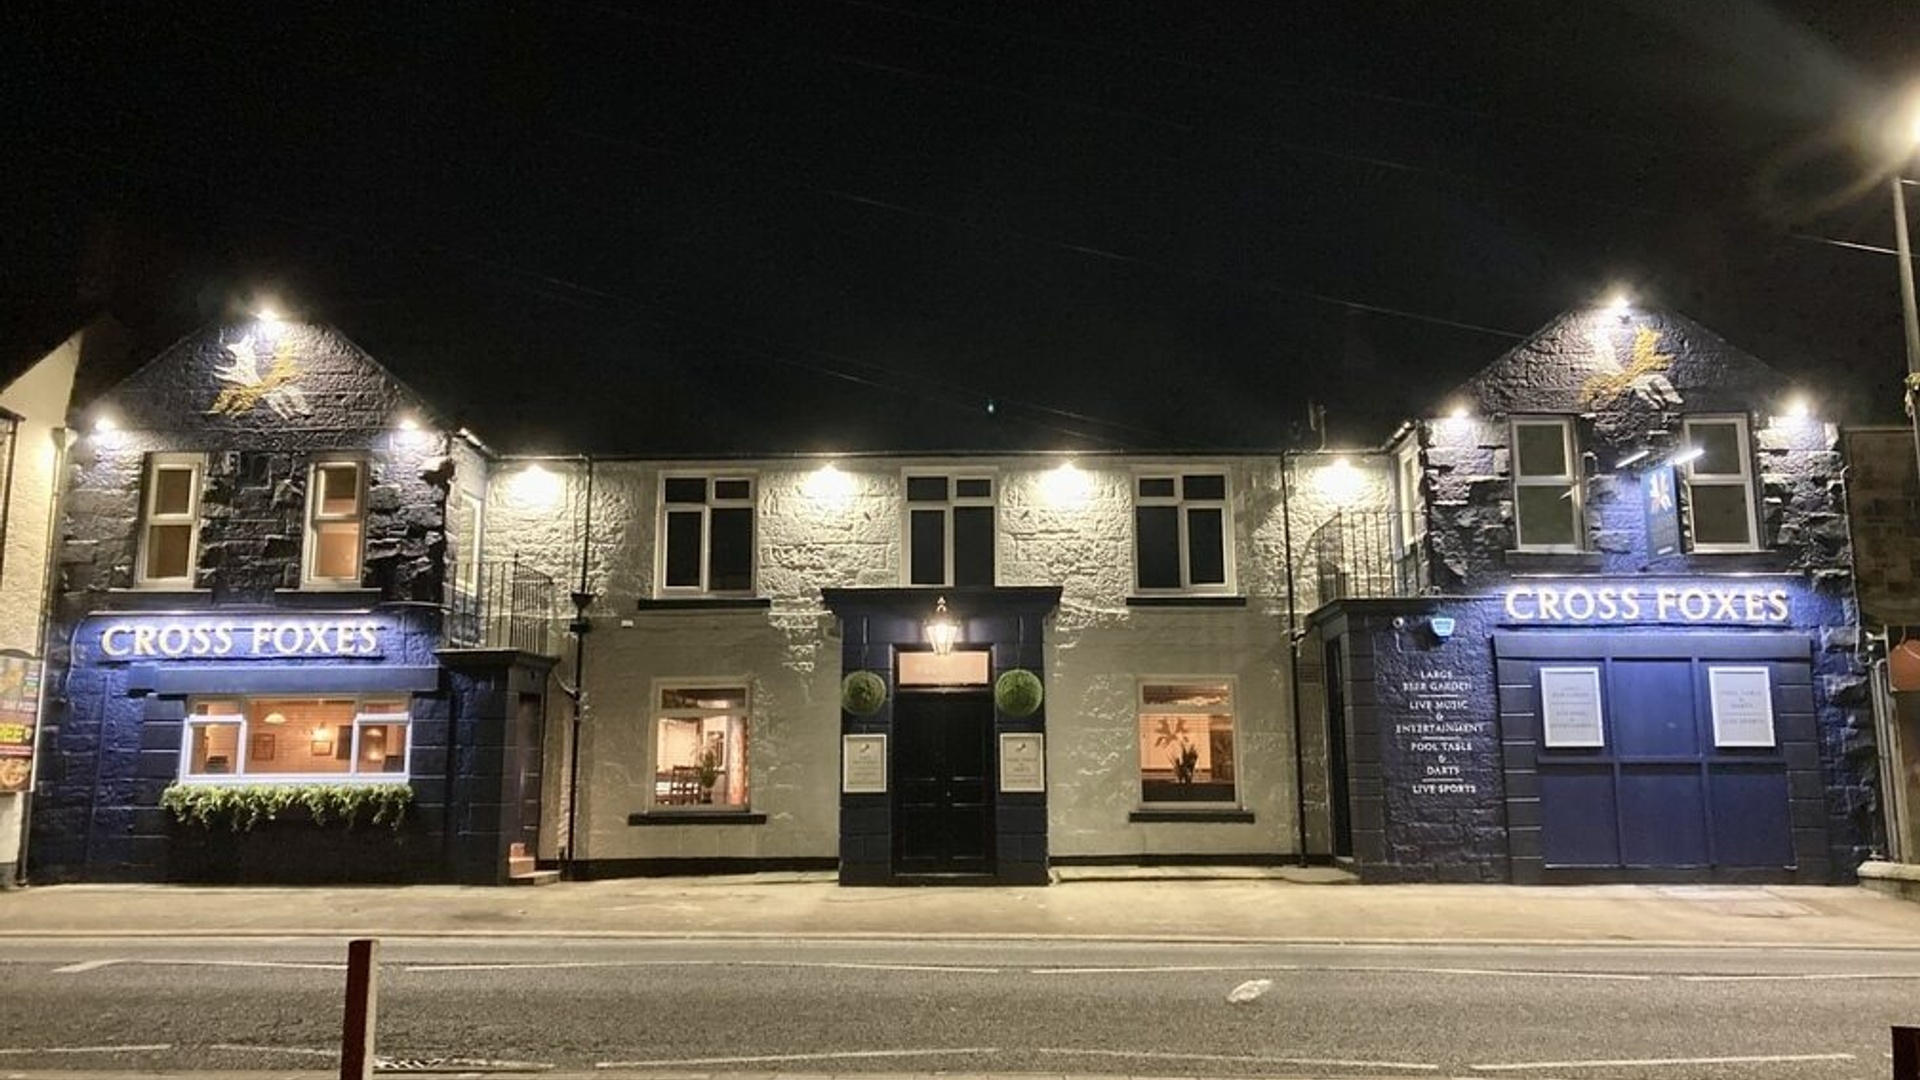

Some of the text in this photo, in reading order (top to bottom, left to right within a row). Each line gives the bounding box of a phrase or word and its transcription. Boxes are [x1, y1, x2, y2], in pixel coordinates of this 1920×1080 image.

[1504, 586, 1789, 621] CROSS FOXES
[101, 620, 378, 656] CROSS FOXES
[1420, 669, 1453, 680] LARGE
[1429, 681, 1473, 692] GARDEN
[1409, 700, 1468, 711] LIVE MUSIC
[1395, 722, 1485, 734] ENTERTAINMENT
[1411, 741, 1473, 752] POOL TABLE
[1426, 765, 1460, 776] DARTS
[1412, 783, 1477, 794] LIVE SPORTS
